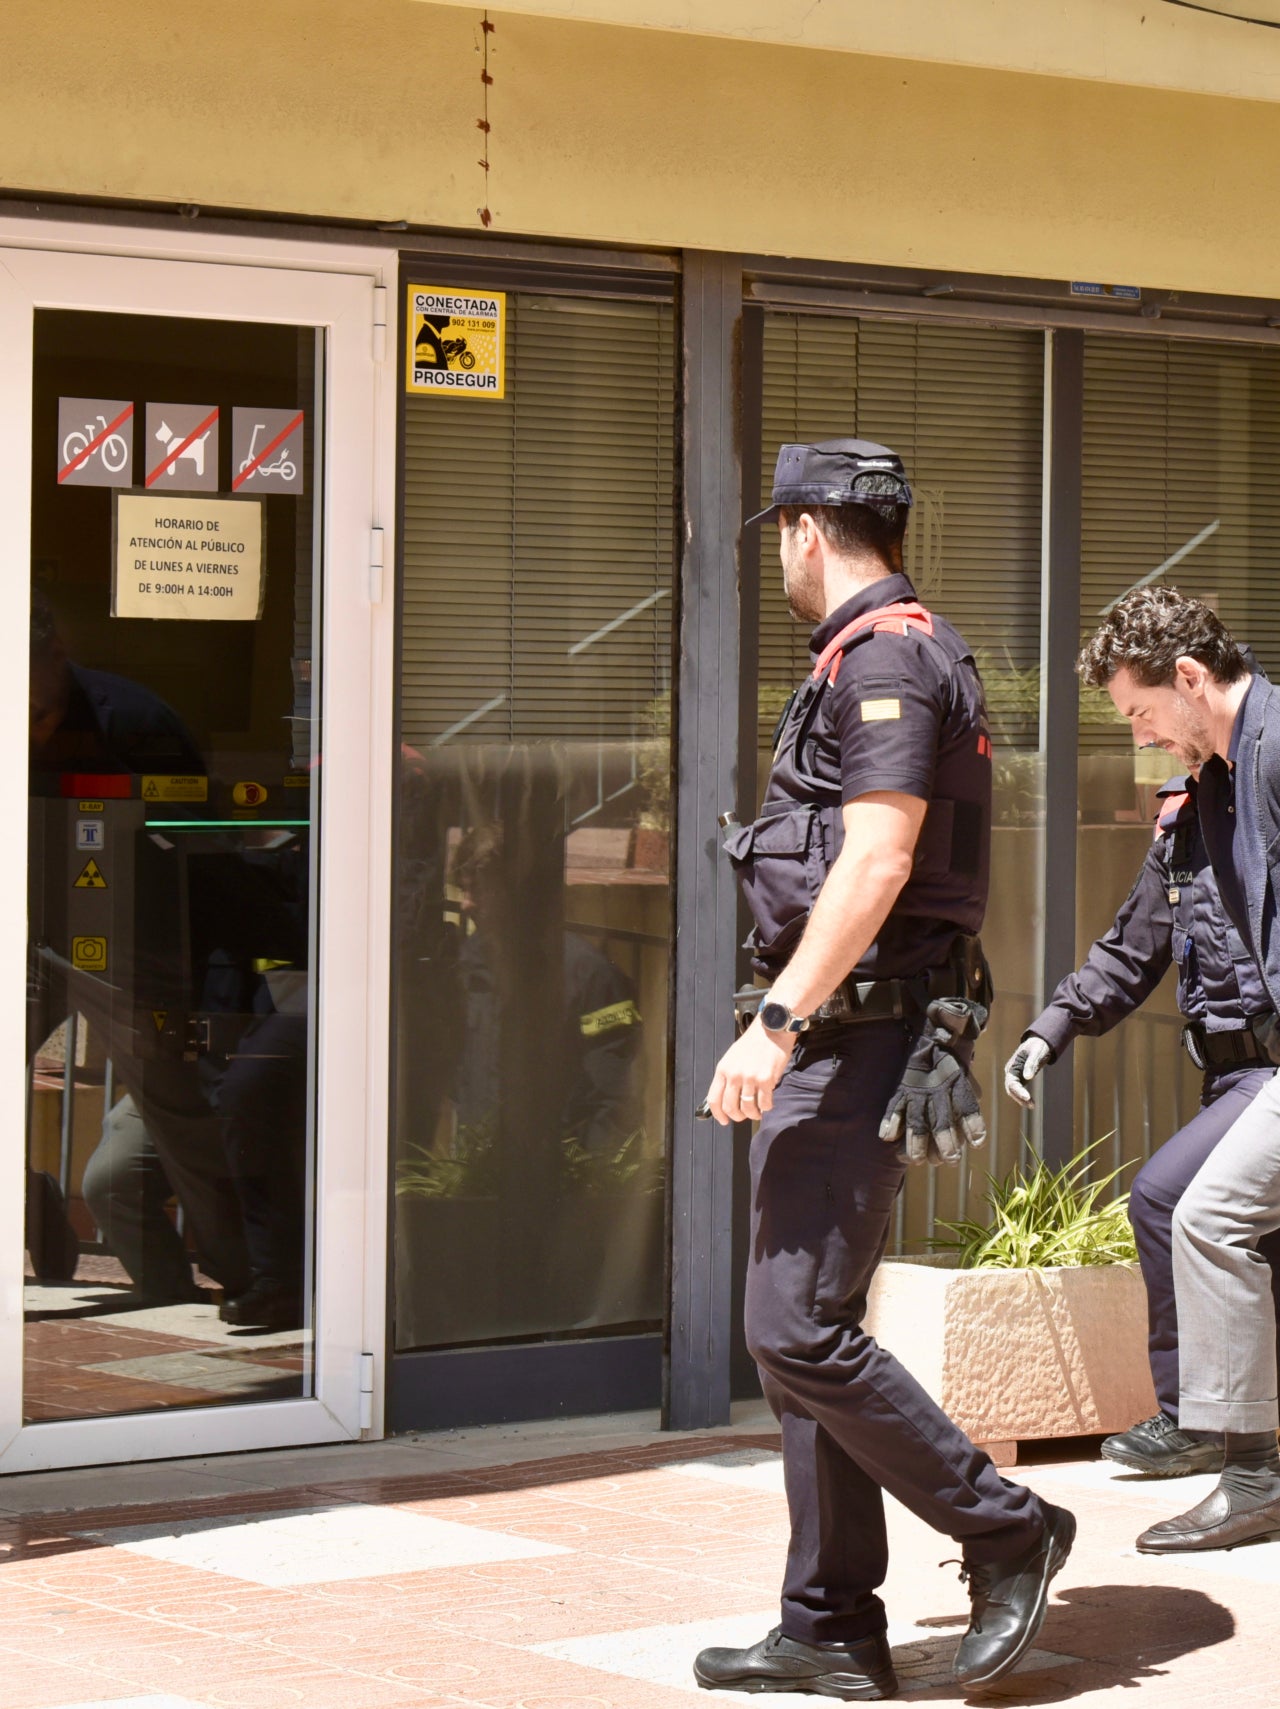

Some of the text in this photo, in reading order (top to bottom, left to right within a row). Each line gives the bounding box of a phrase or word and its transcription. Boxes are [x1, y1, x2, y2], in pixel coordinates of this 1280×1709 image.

[416, 295, 497, 311] CONECTADA
[430, 307, 457, 315] CENTRAL
[452, 318, 465, 326] 902
[414, 371, 497, 388] PROSEGUR
[155, 518, 220, 531] HORARIO DE
[130, 537, 245, 553] ATENCIÓN AL PÚBLICO
[134, 560, 239, 575] DE LUNES A VIERNES
[139, 583, 233, 597] DE 9:00H A 14:00H
